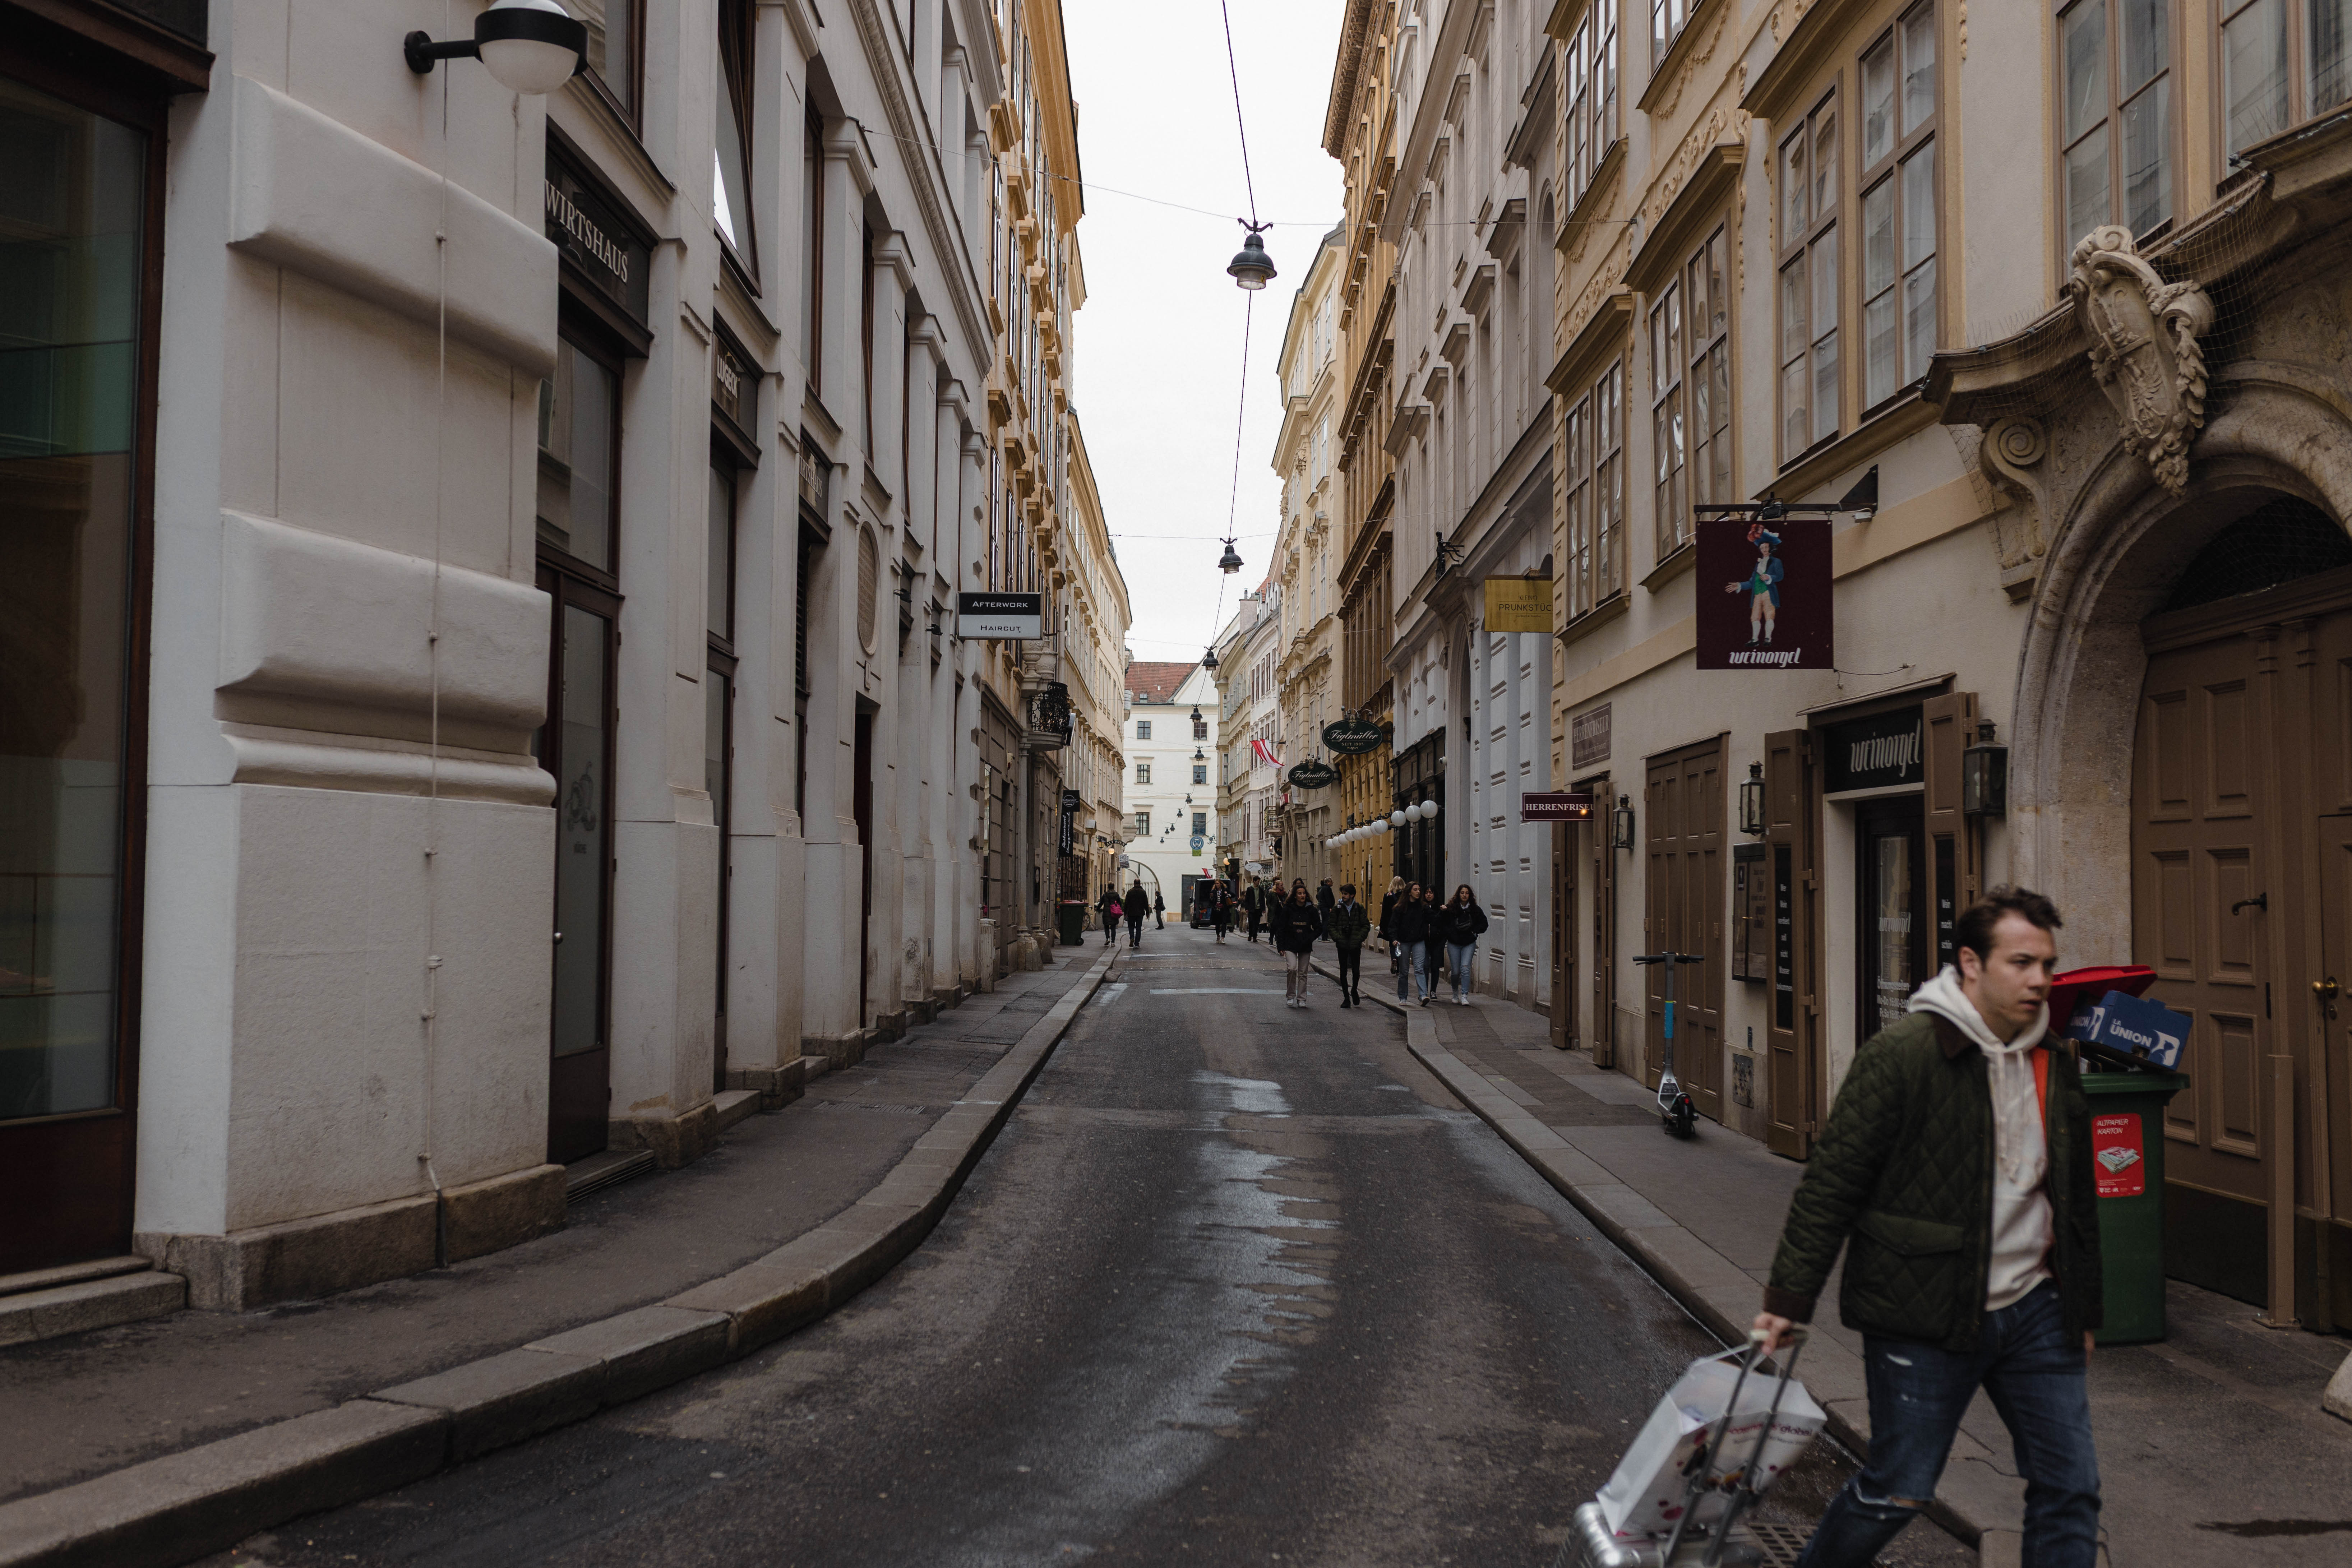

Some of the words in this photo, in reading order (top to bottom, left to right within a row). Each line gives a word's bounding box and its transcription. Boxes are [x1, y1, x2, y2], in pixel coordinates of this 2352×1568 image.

[545, 178, 627, 283] WIRTSHAUS
[717, 354, 738, 398] LUGECK
[799, 454, 822, 498] IRTSHAUS
[1499, 603, 1552, 611] PRUNKSTÜC
[1729, 647, 1801, 667] weinorgel
[1329, 730, 1378, 742] Figlmüller
[1574, 715, 1609, 744] HERRENFRISEUR
[1851, 718, 1921, 777] weinorgel
[1293, 771, 1330, 780] Figlmüller
[2110, 1024, 2152, 1047] UNION
